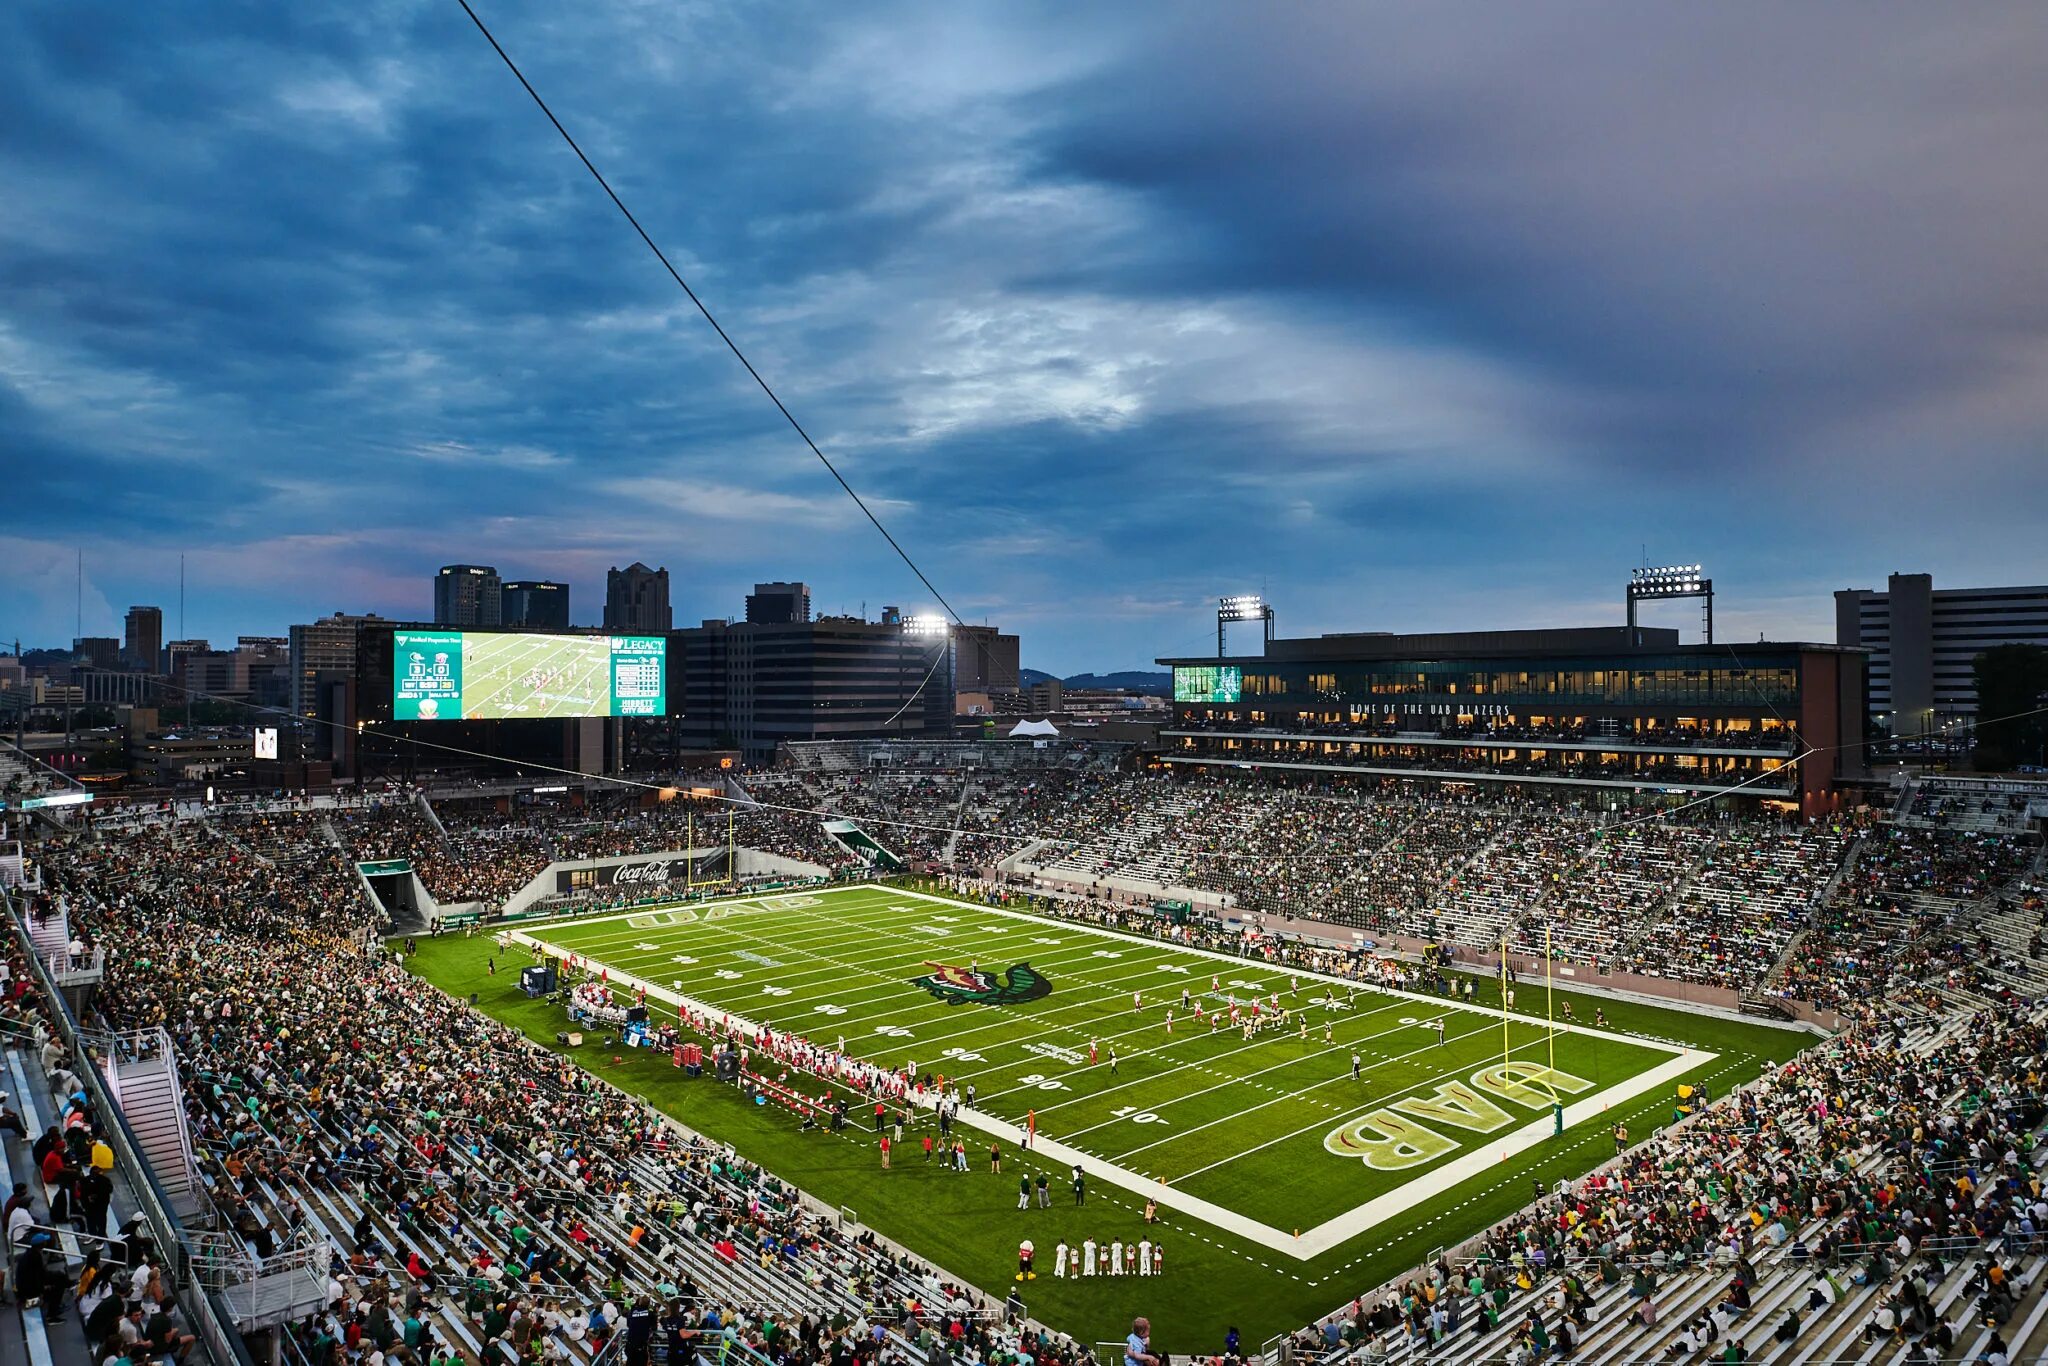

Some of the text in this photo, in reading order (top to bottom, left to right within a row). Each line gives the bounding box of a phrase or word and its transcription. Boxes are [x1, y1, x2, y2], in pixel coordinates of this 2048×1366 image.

[624, 639, 664, 650] LEGACY
[1350, 704, 1509, 716] HOME OF THE UAB BLAZERS
[613, 860, 672, 885] Coca-Cola
[627, 896, 823, 928] UAB
[1017, 1074, 1062, 1091] 20
[1110, 1106, 1159, 1125] 10
[1324, 1061, 1597, 1171] UAB
